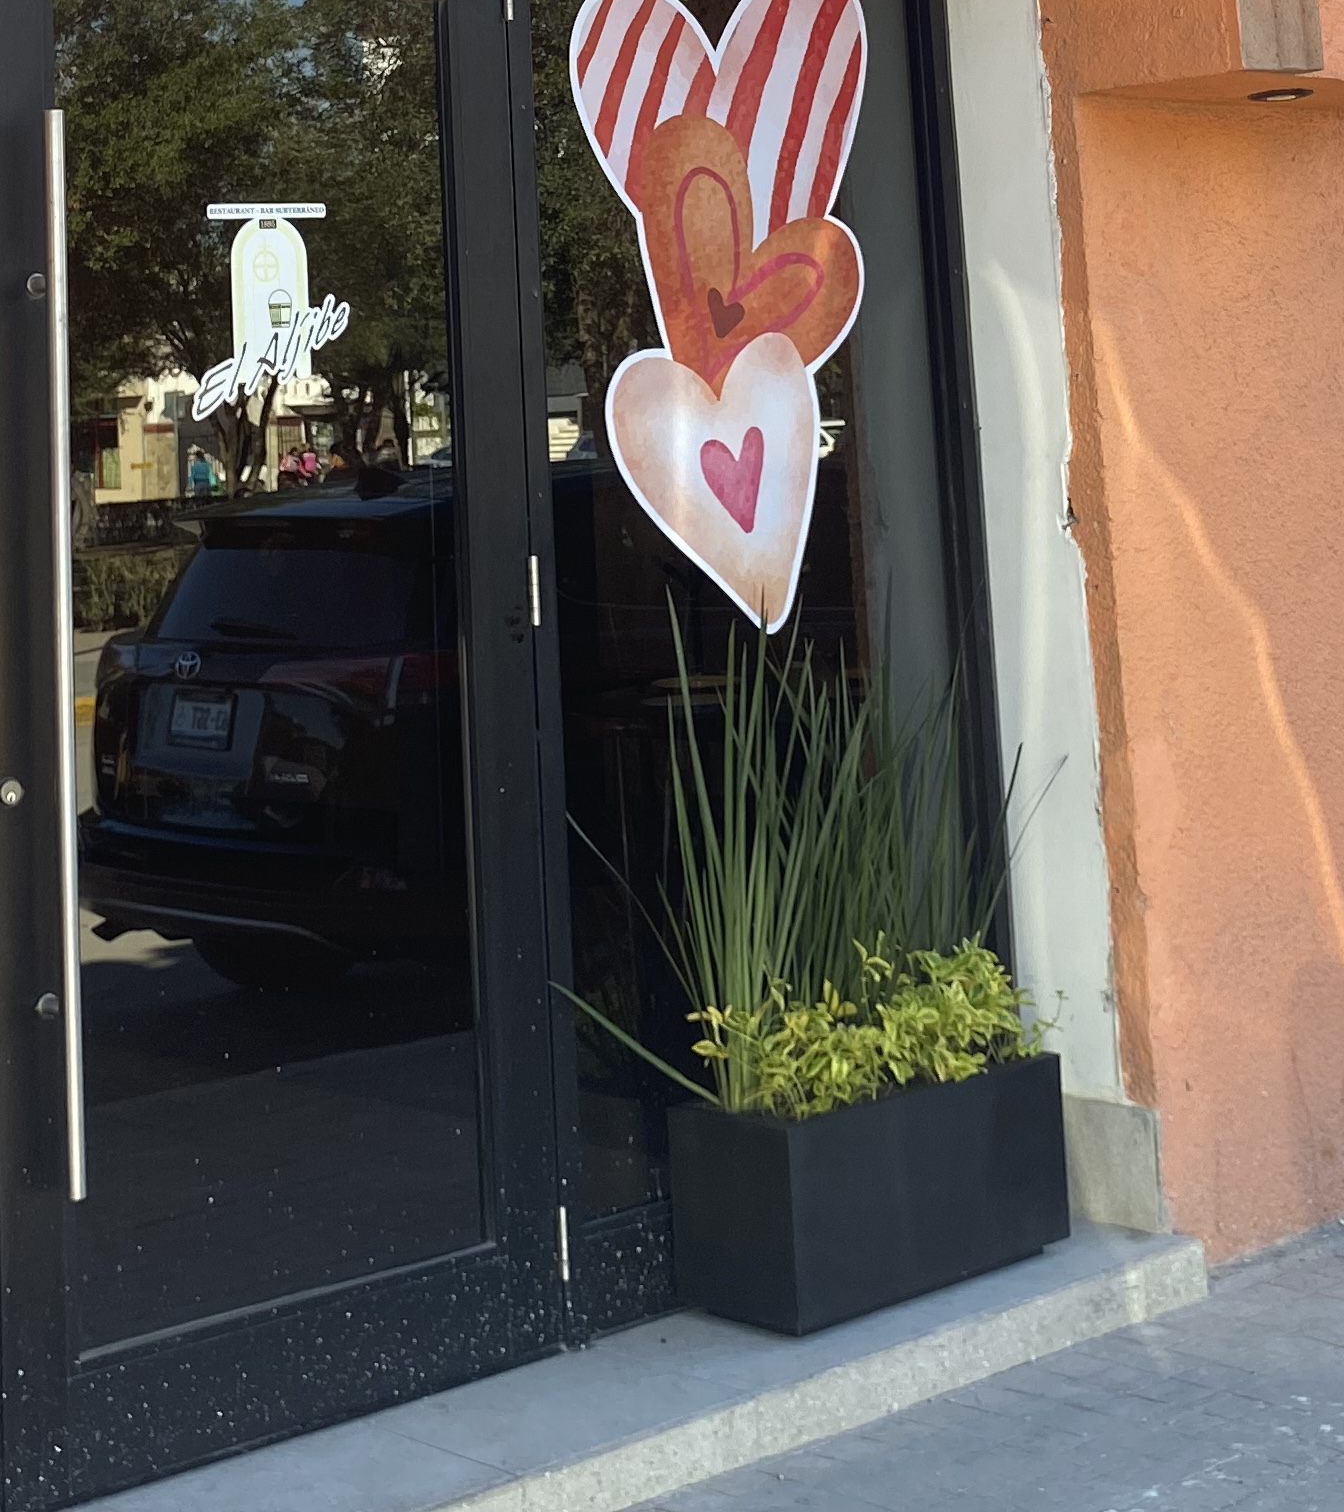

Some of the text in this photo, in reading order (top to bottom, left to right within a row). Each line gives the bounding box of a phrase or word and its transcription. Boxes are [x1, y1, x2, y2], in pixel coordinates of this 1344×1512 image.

[209, 207, 255, 215] RESTAURANT
[260, 207, 274, 215] BAR
[195, 296, 348, 416] El Aljibe
